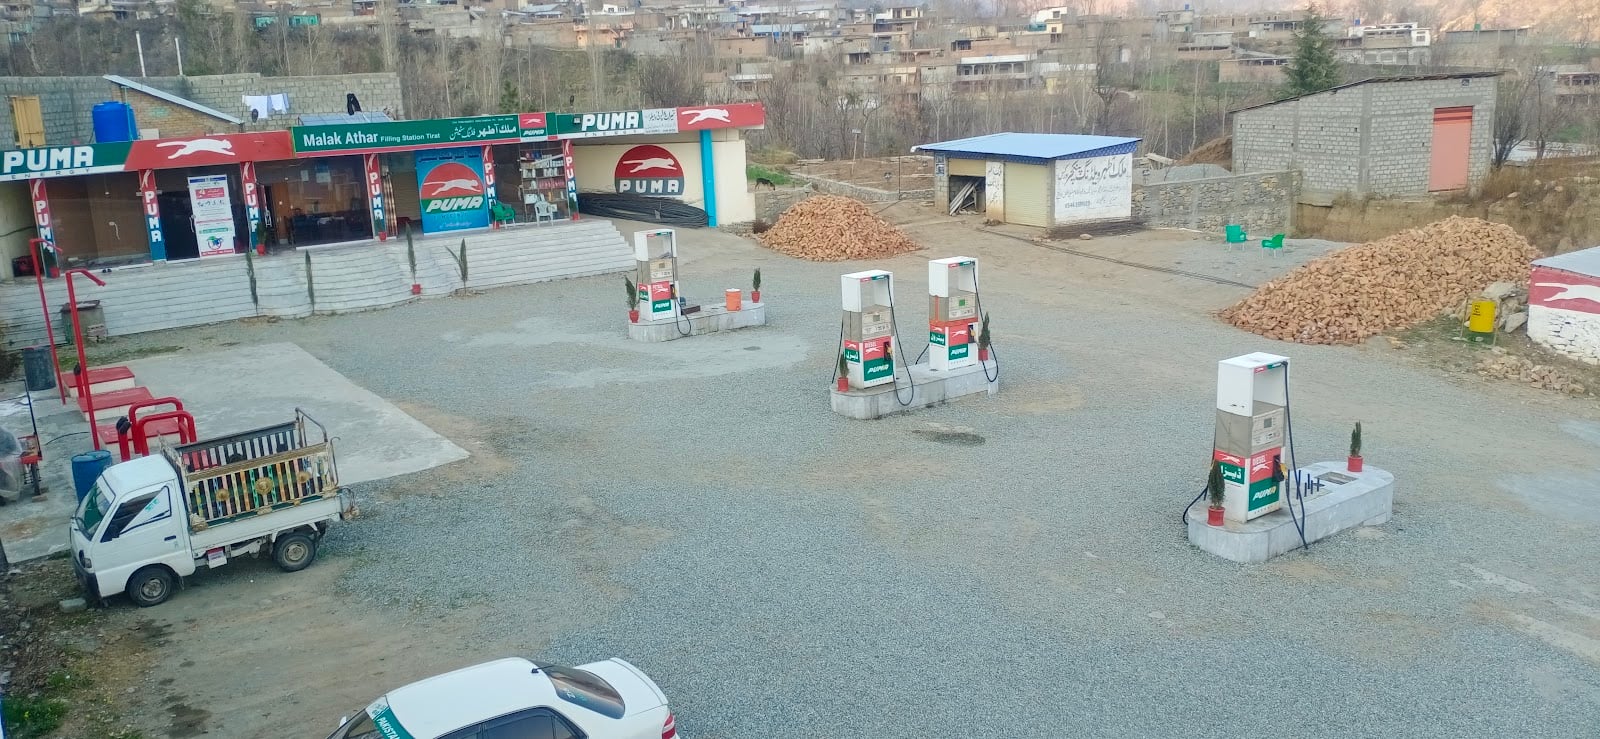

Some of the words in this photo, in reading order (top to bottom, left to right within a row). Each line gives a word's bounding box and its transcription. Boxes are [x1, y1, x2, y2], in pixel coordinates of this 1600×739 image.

[581, 111, 639, 132] PUMA
[303, 132, 342, 147] Malak
[345, 131, 379, 145] Athar
[380, 135, 401, 143] Filling
[522, 129, 545, 137] PUMA
[3, 145, 94, 174] PUMA
[11, 168, 90, 180] ENERGY
[619, 179, 680, 193] PUMA
[369, 171, 384, 220] PUMA
[426, 196, 483, 213] PUMA
[145, 190, 162, 243] PUMA
[867, 364, 890, 374] PUMA
[1252, 454, 1267, 466] DIESEL
[1253, 485, 1277, 501] PUMA
